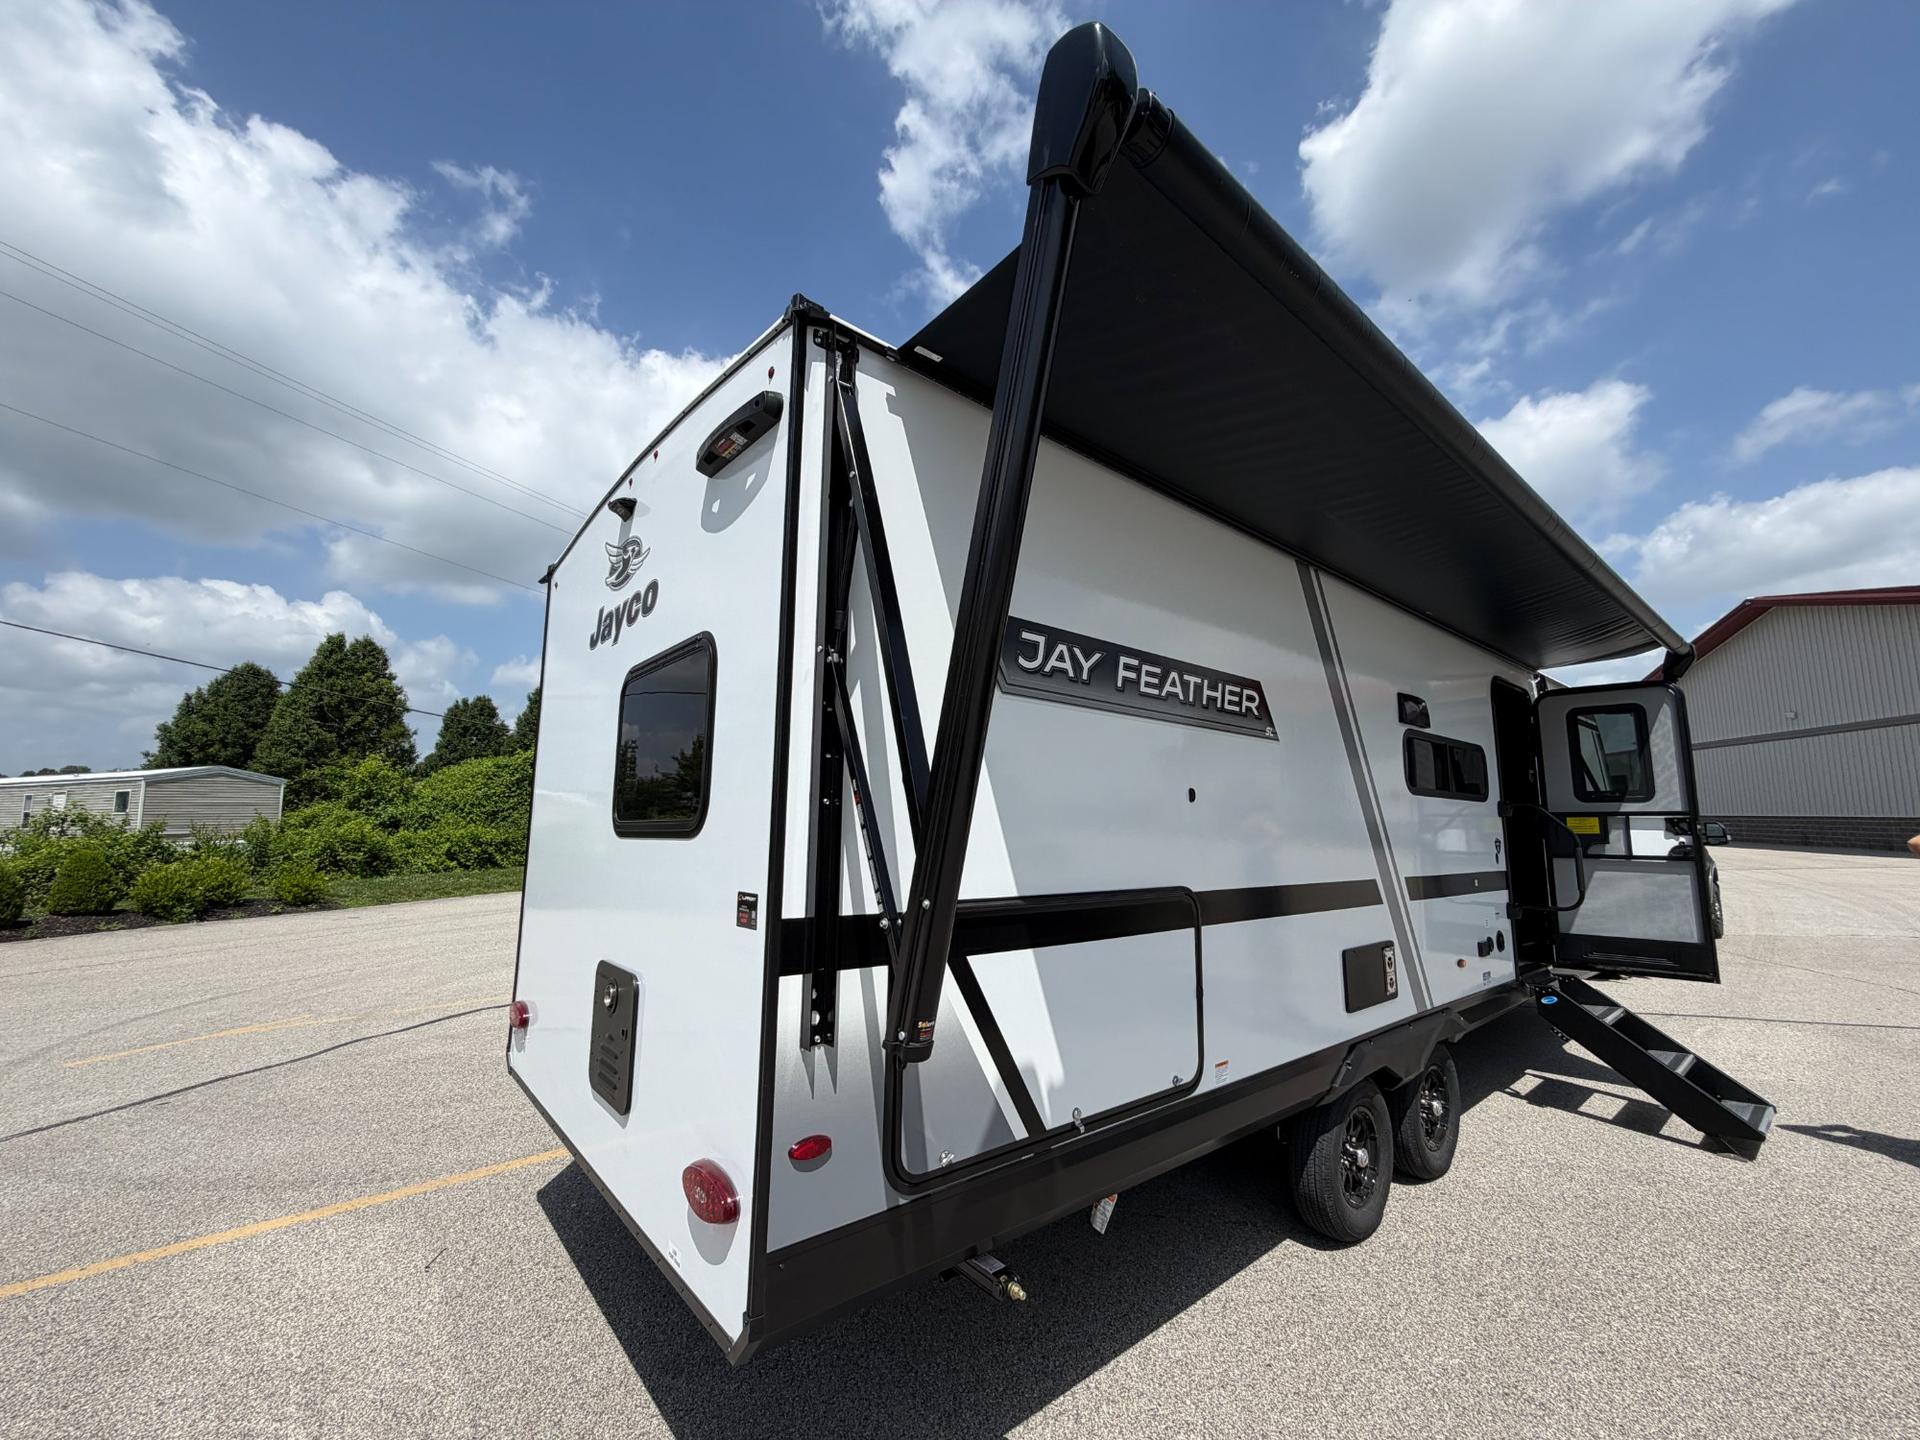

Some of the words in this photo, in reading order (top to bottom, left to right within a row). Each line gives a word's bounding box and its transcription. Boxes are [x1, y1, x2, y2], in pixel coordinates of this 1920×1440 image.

[589, 578, 659, 651] Jayco
[1017, 630, 1102, 681] JAY
[1116, 655, 1261, 718] FEATHER
